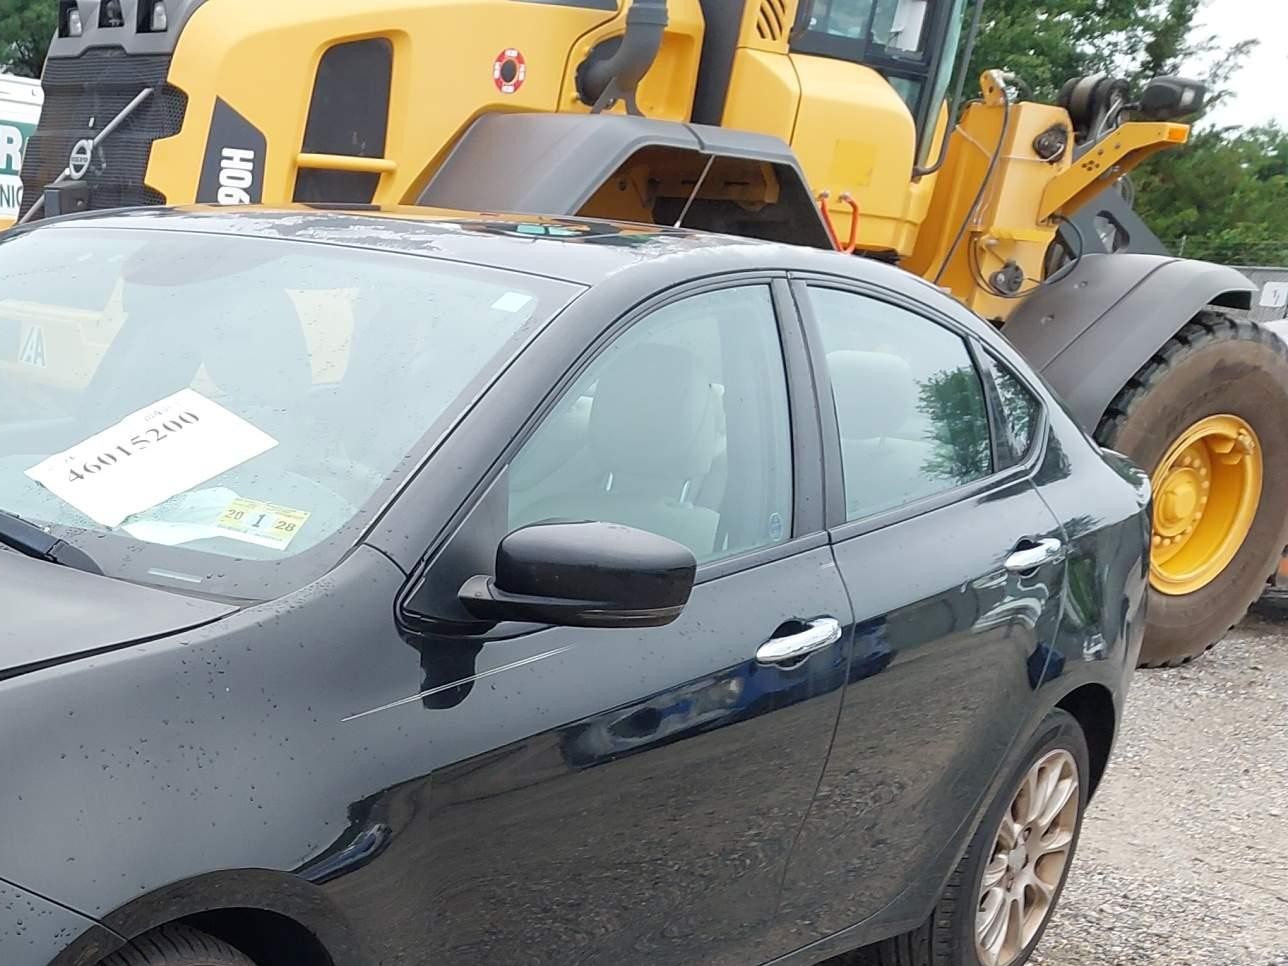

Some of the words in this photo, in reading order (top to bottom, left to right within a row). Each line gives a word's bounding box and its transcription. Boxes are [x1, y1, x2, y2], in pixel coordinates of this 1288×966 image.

[68, 411, 200, 482] 46015200
[224, 509, 244, 520] 20
[252, 513, 266, 528] 1
[275, 520, 297, 532] 28
